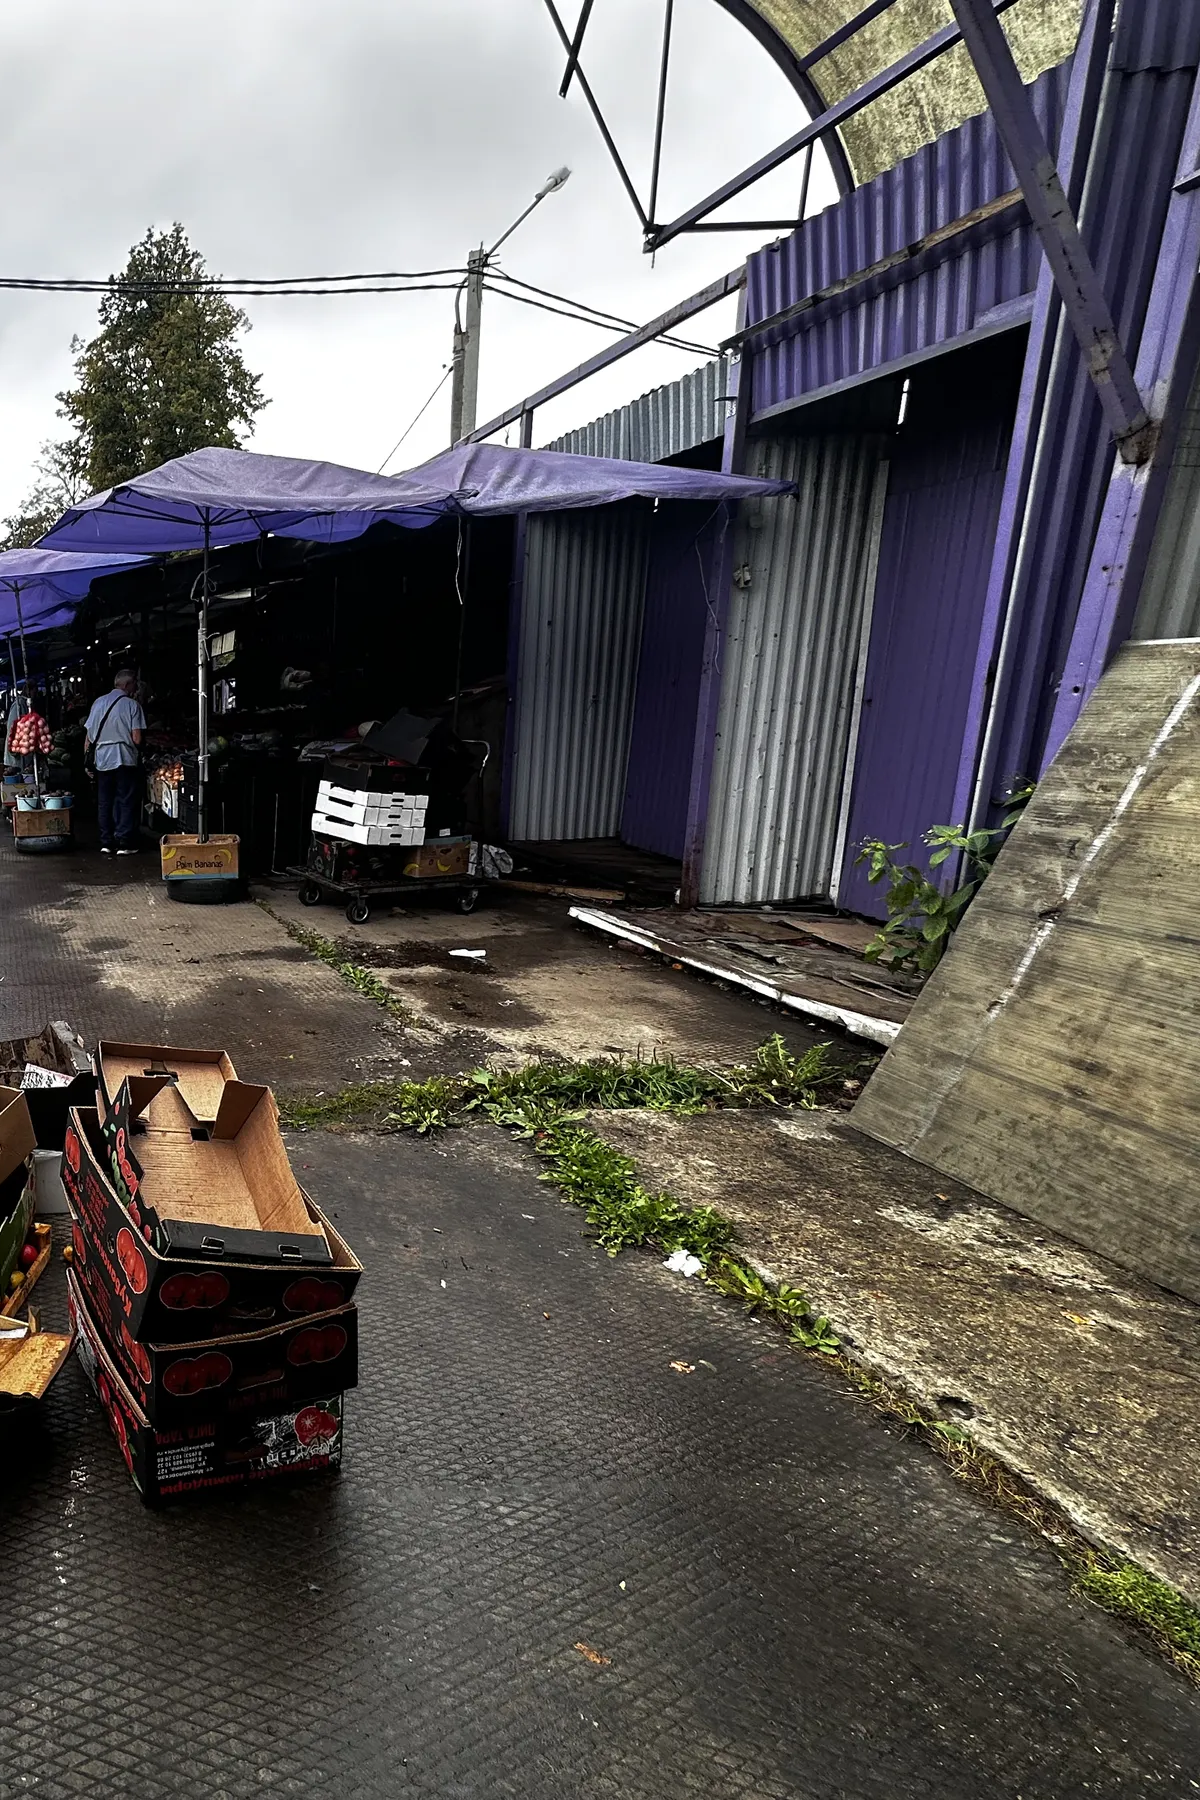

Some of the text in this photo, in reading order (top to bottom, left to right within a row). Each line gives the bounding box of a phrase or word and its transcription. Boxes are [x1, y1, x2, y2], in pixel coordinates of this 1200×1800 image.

[175, 860, 224, 868] Palm Bananas
[160, 1475, 244, 1495] помидоры
